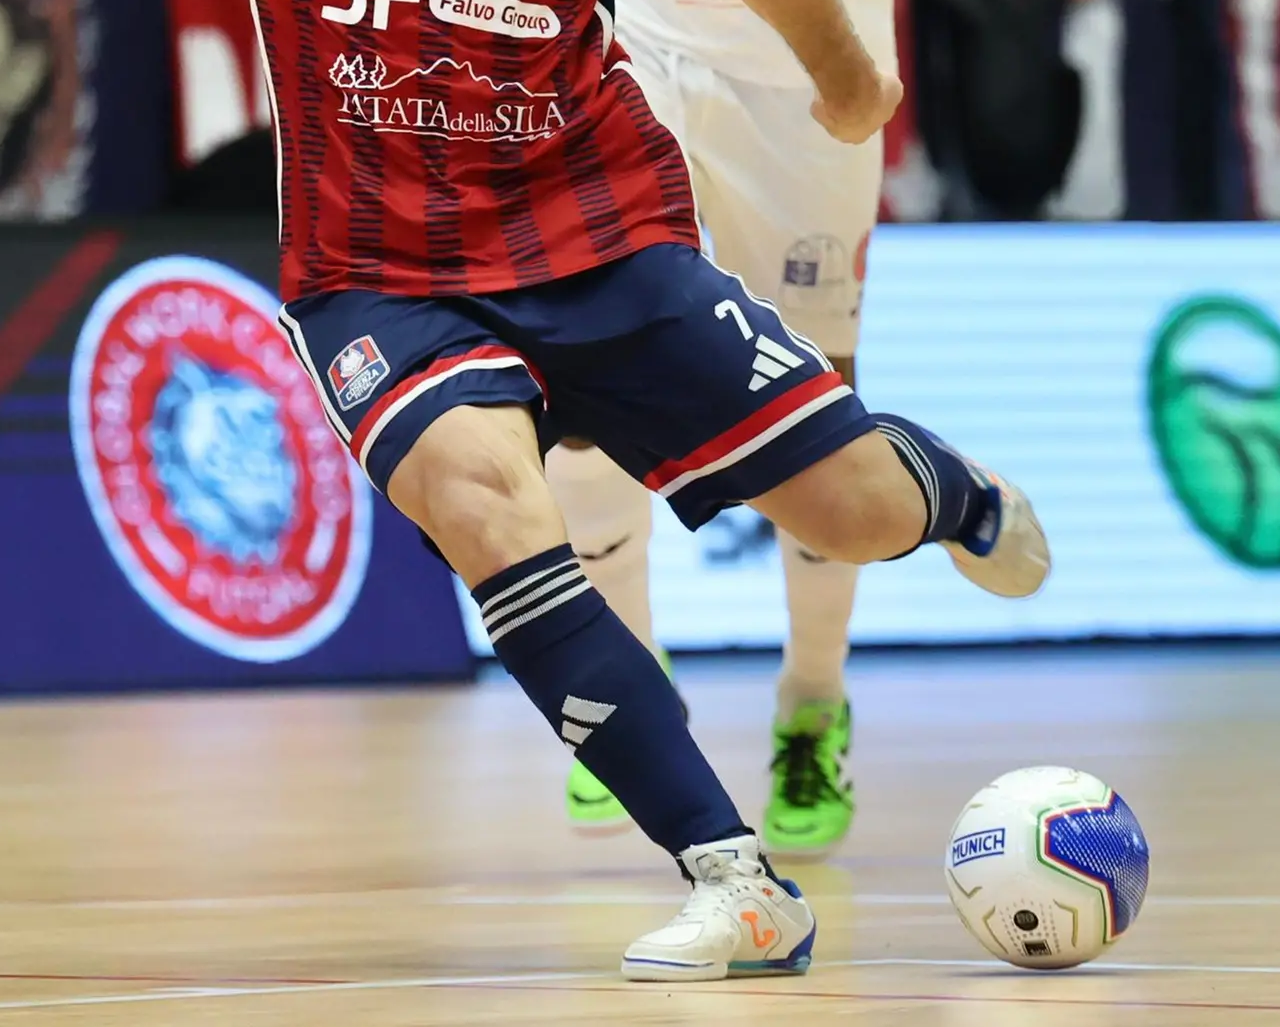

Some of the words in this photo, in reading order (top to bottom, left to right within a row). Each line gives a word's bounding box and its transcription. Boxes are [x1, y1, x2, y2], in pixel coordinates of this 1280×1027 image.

[501, 4, 551, 35] Group
[714, 299, 754, 341] 7
[952, 834, 1005, 860] MUNICH
